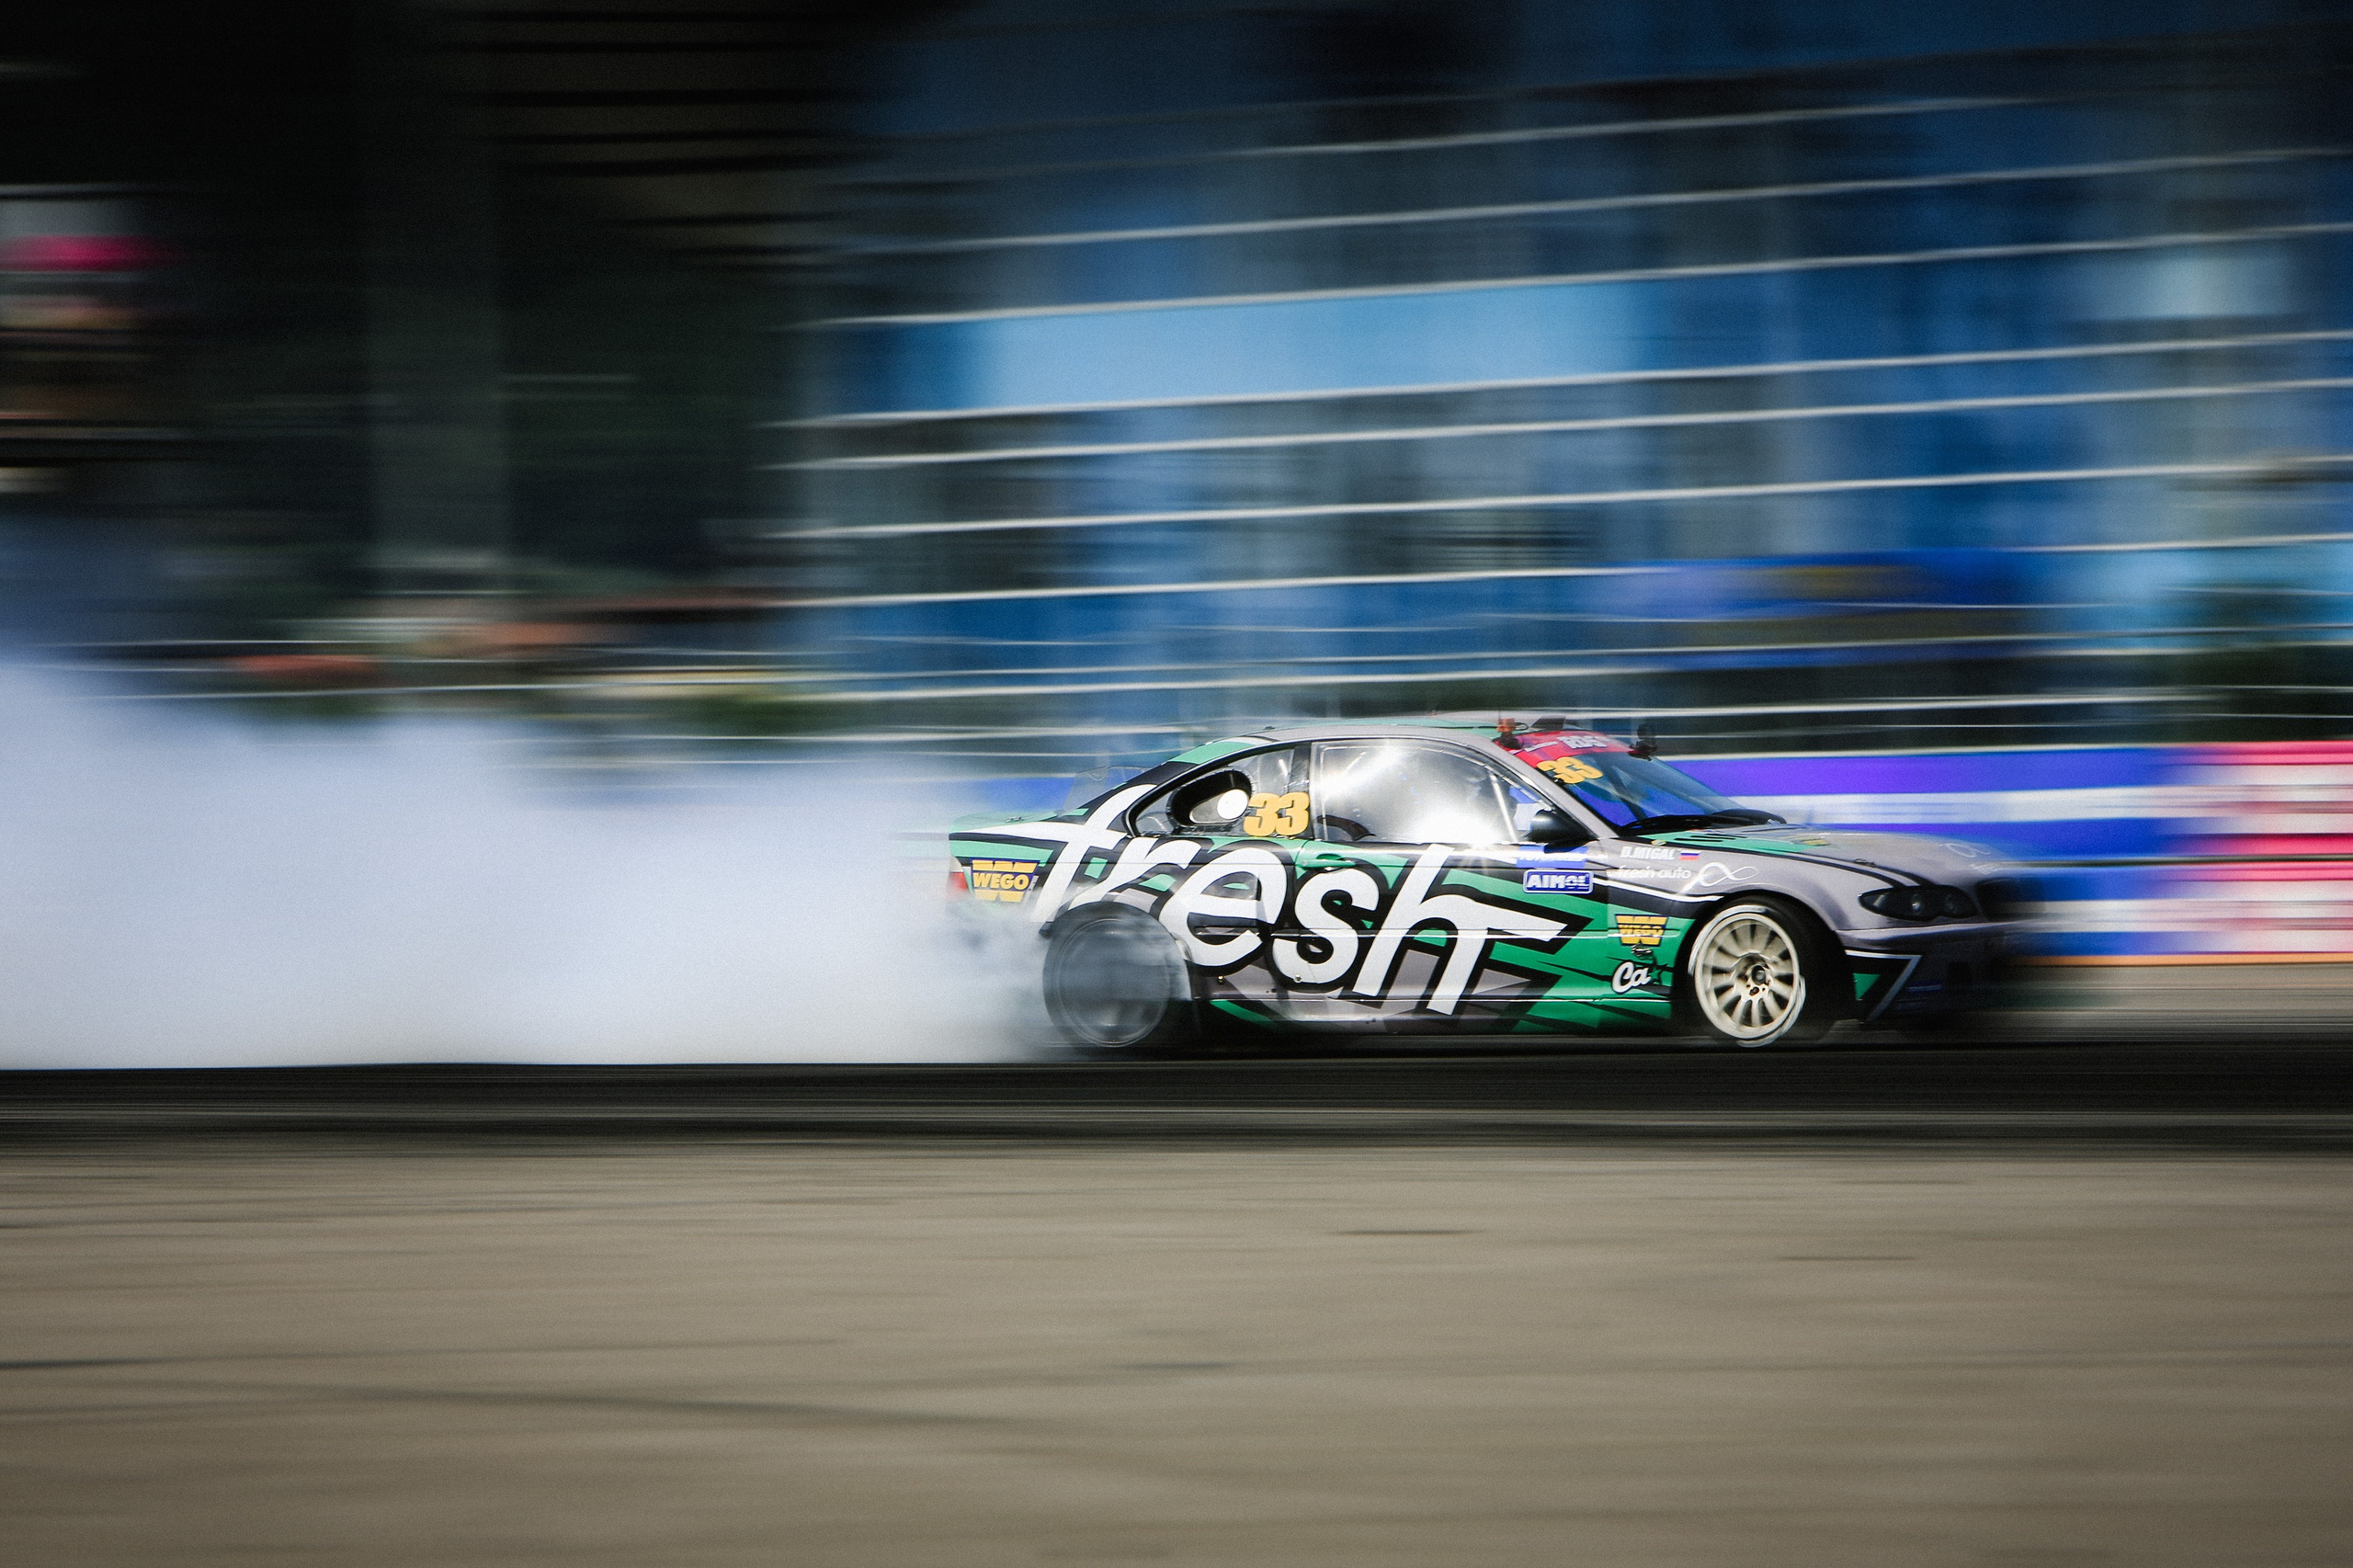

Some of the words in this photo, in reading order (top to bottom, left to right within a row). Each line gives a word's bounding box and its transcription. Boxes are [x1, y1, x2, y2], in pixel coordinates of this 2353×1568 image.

[1243, 791, 1310, 837] 33
[972, 872, 1029, 891] WEGO
[1526, 874, 1589, 890] AIMOL
[1657, 867, 1691, 880] auto
[1020, 783, 1568, 1016] fresh
